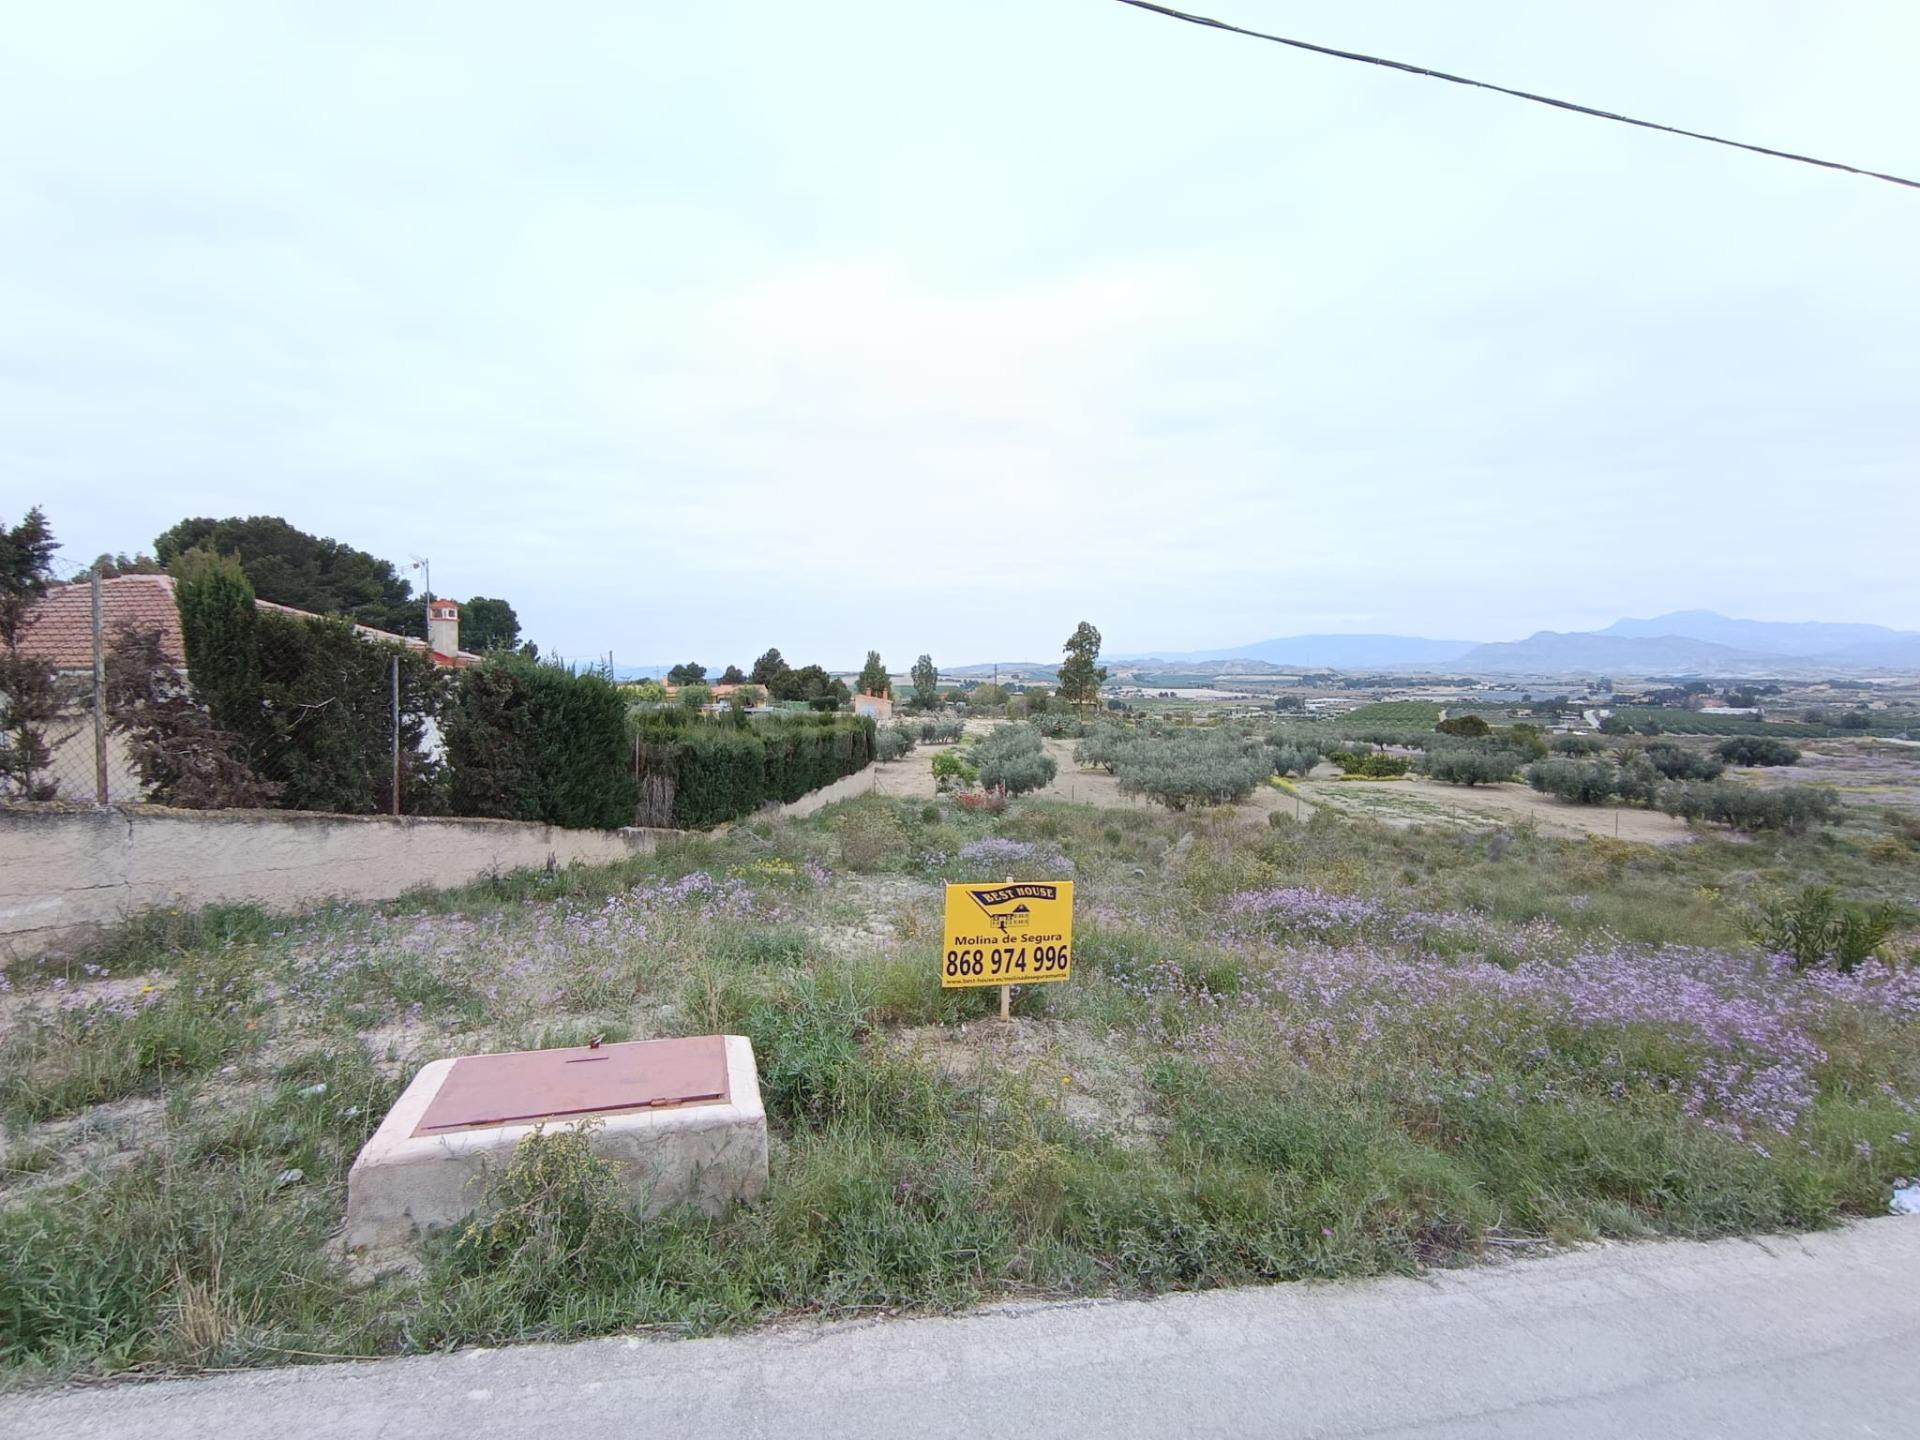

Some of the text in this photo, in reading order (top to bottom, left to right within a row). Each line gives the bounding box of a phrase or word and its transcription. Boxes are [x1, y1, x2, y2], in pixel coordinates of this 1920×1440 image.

[982, 886, 1055, 903] BEST HOUSE
[954, 933, 1062, 946] Molina de Segura
[946, 945, 1068, 976] 868 974 996
